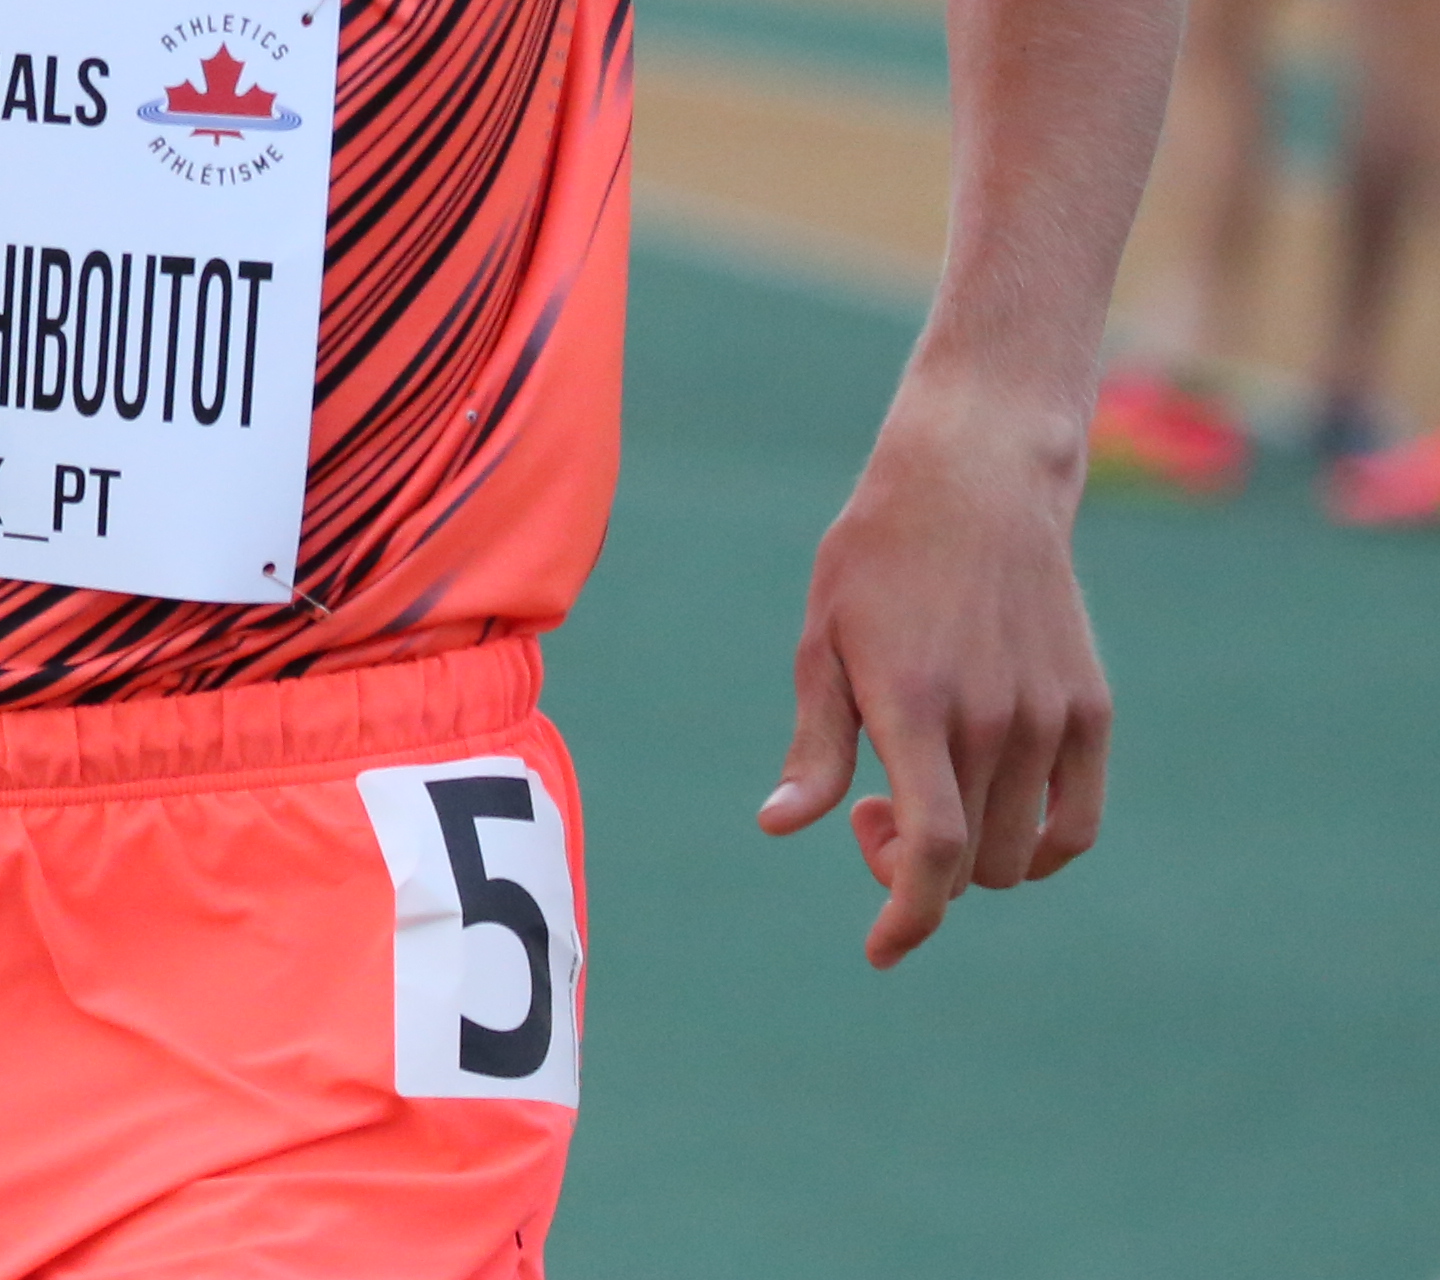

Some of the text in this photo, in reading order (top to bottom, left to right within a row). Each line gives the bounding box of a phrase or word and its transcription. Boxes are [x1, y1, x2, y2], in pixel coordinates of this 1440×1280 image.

[160, 14, 289, 61] ATHLETICS
[148, 134, 284, 186] ATHLÉTISME
[424, 775, 554, 1078] 5
